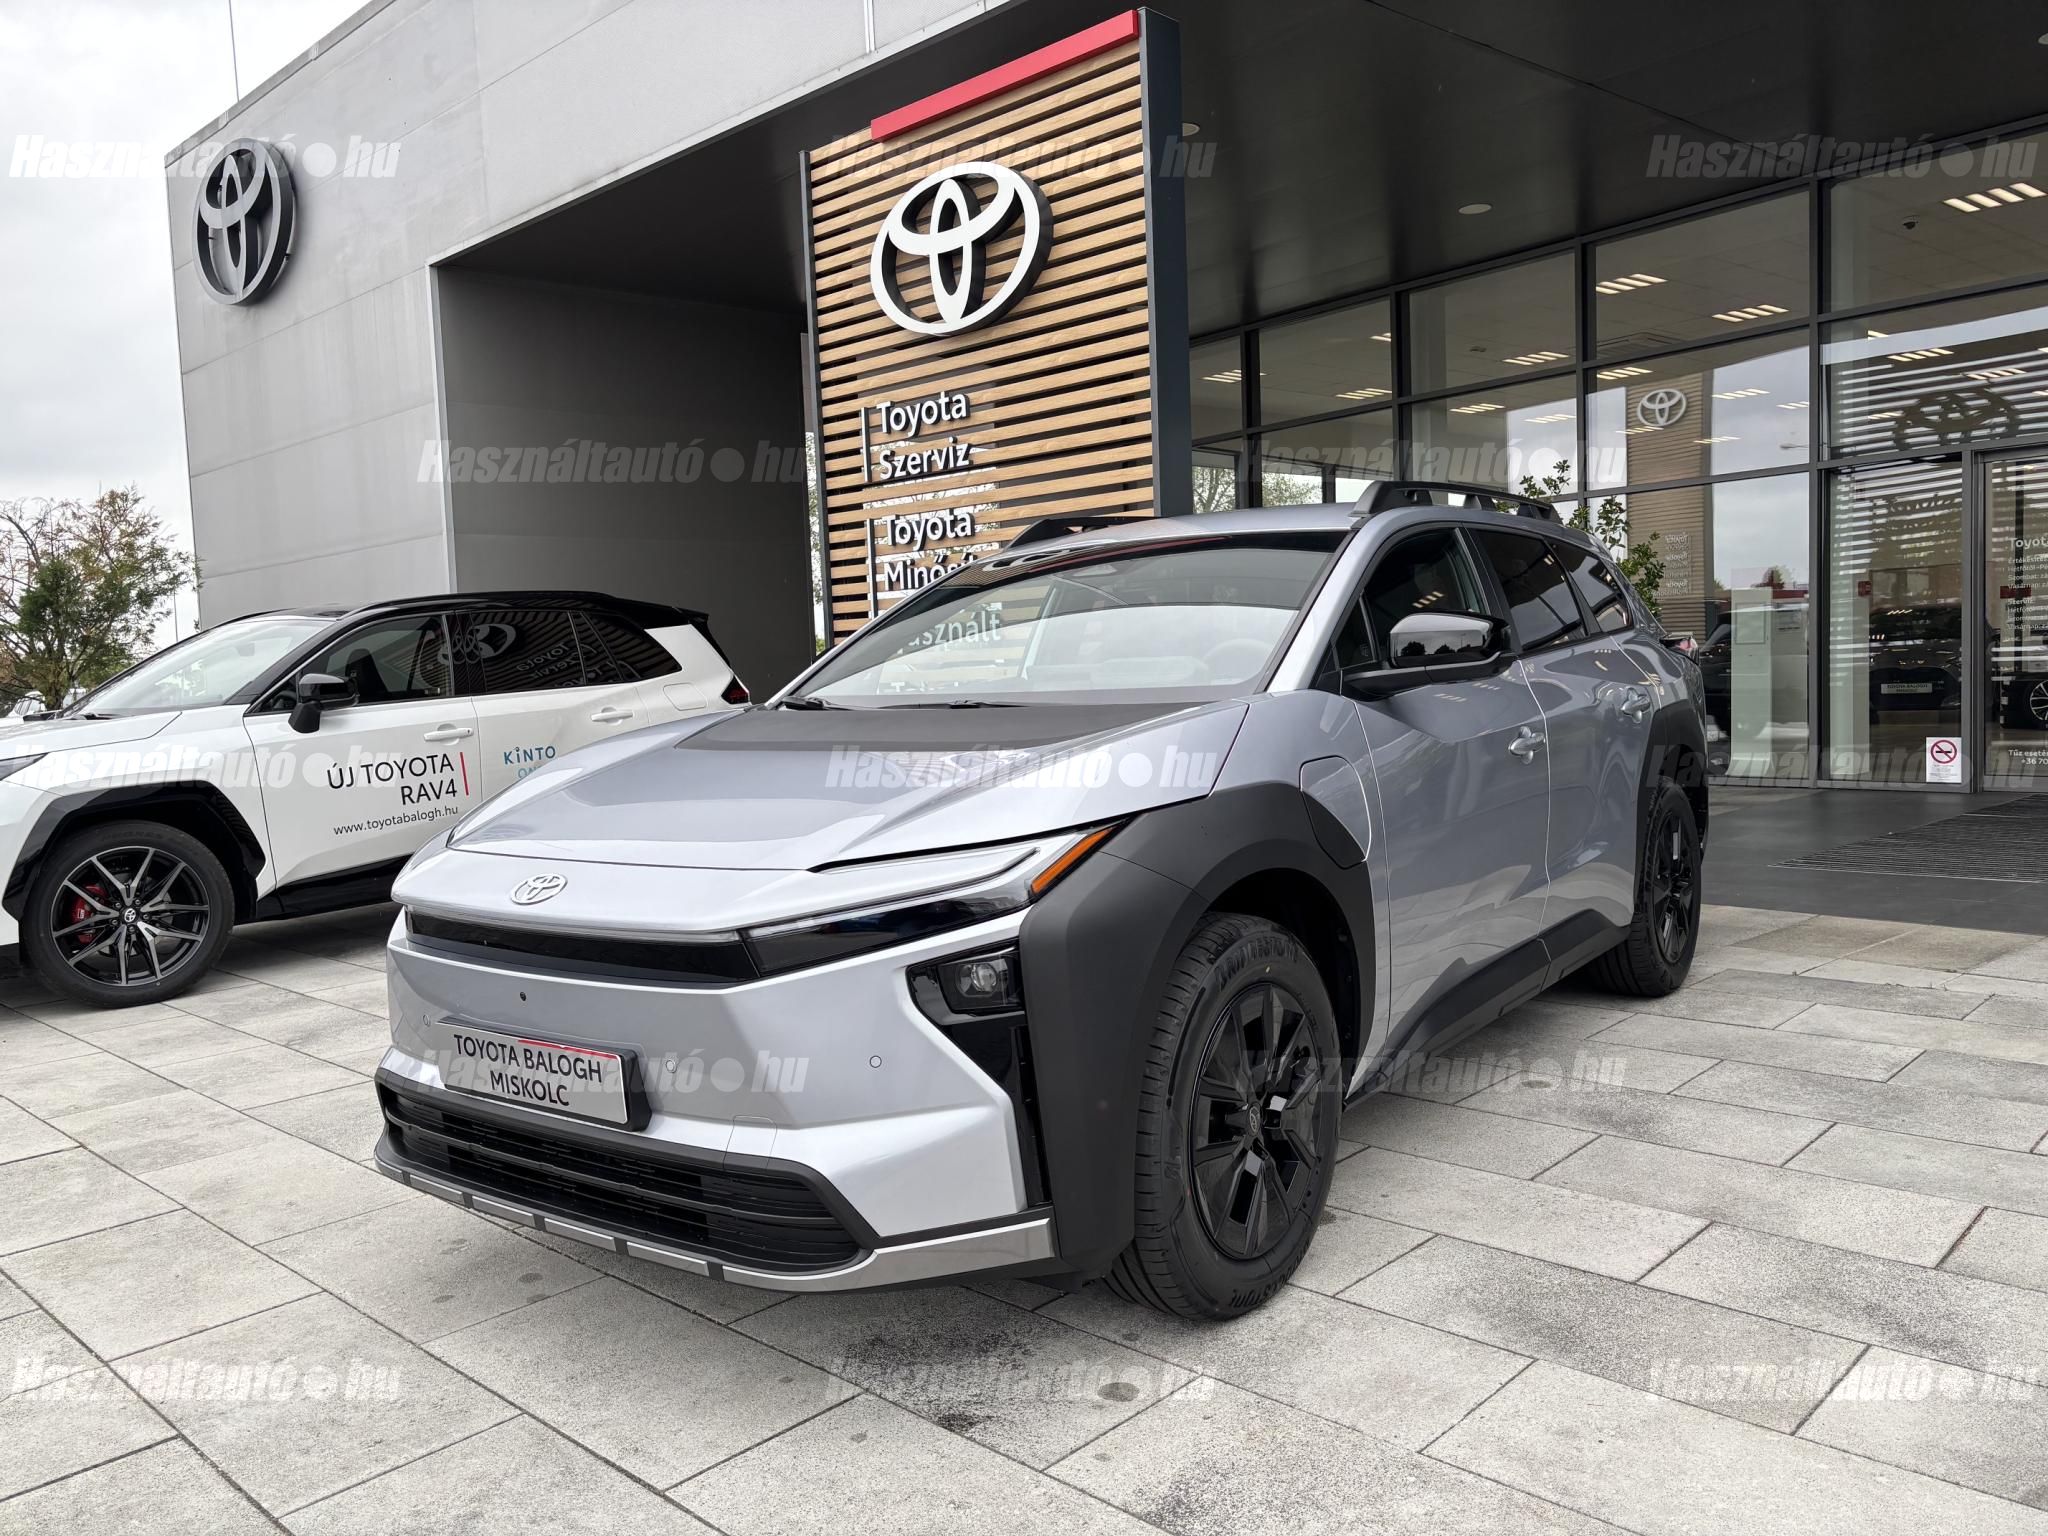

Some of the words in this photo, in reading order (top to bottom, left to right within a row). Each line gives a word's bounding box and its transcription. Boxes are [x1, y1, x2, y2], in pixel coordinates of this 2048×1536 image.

[876, 391, 968, 437] Toyota
[879, 436, 970, 479] Szerviz
[882, 510, 973, 551] Toyota
[2009, 537, 2048, 551] Toyot
[327, 762, 355, 789] ÚJ
[360, 753, 455, 785] TOYOTA
[400, 778, 457, 805] RAV4
[333, 805, 459, 835] www.toyotabalogh.hu
[454, 1034, 520, 1068] TOYOTA
[524, 1048, 602, 1083] BALOGH
[490, 1070, 570, 1107] MISKOLC
